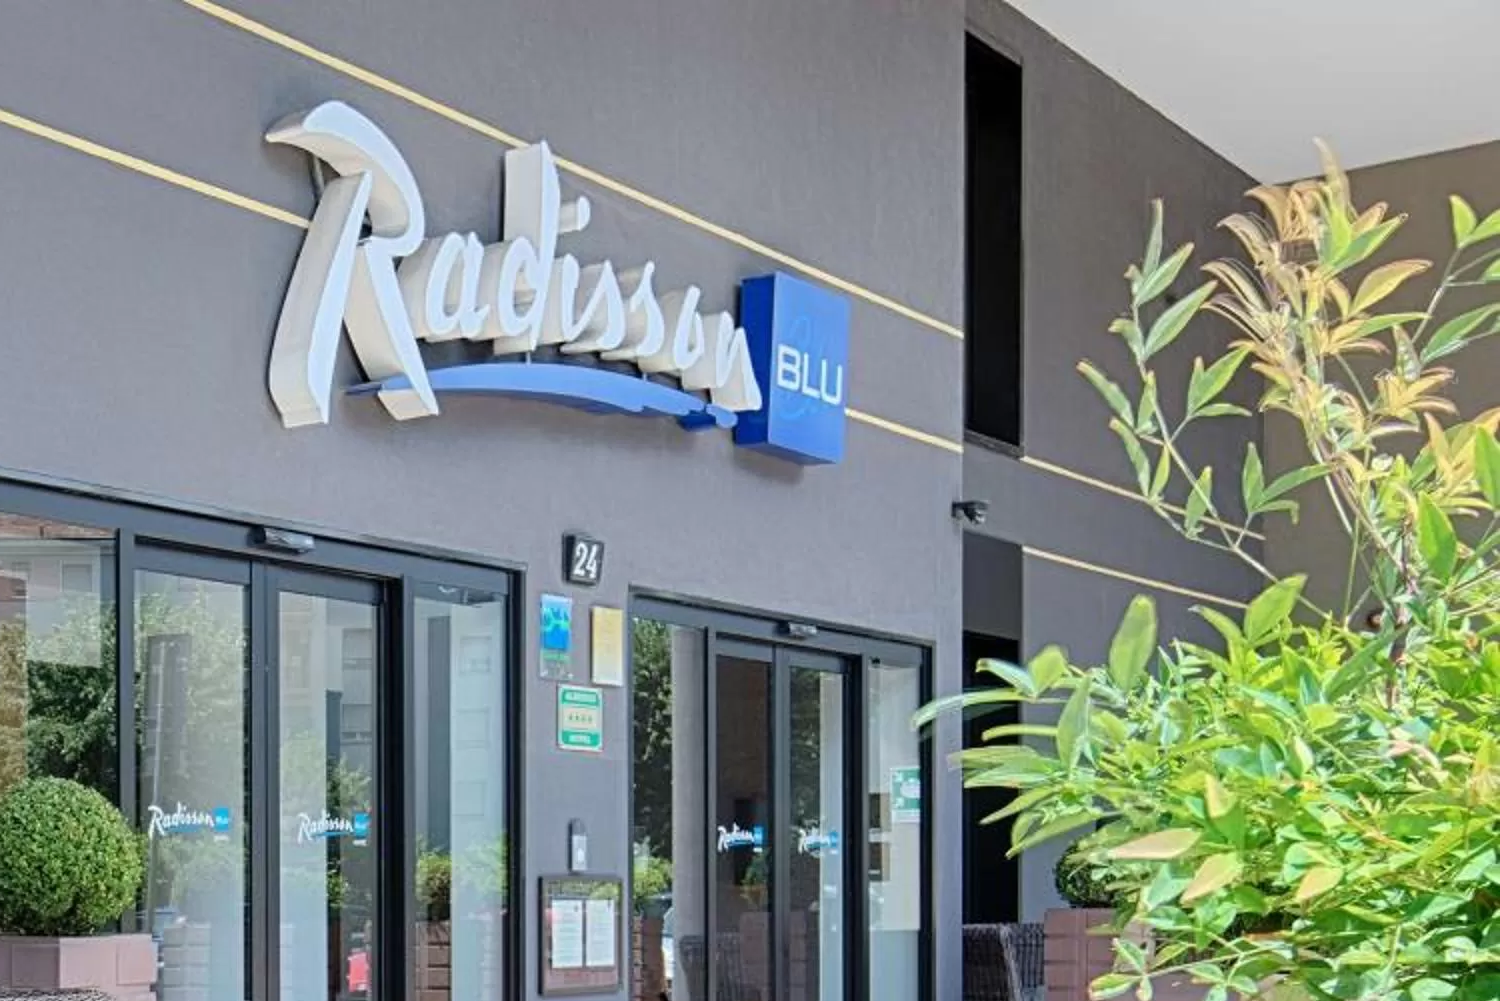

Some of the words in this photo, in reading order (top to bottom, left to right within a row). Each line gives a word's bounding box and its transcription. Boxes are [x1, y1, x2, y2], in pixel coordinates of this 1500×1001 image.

[265, 100, 761, 428] Radisson
[776, 349, 843, 404] BLU
[573, 542, 597, 579] 24
[148, 801, 214, 840] Radisson
